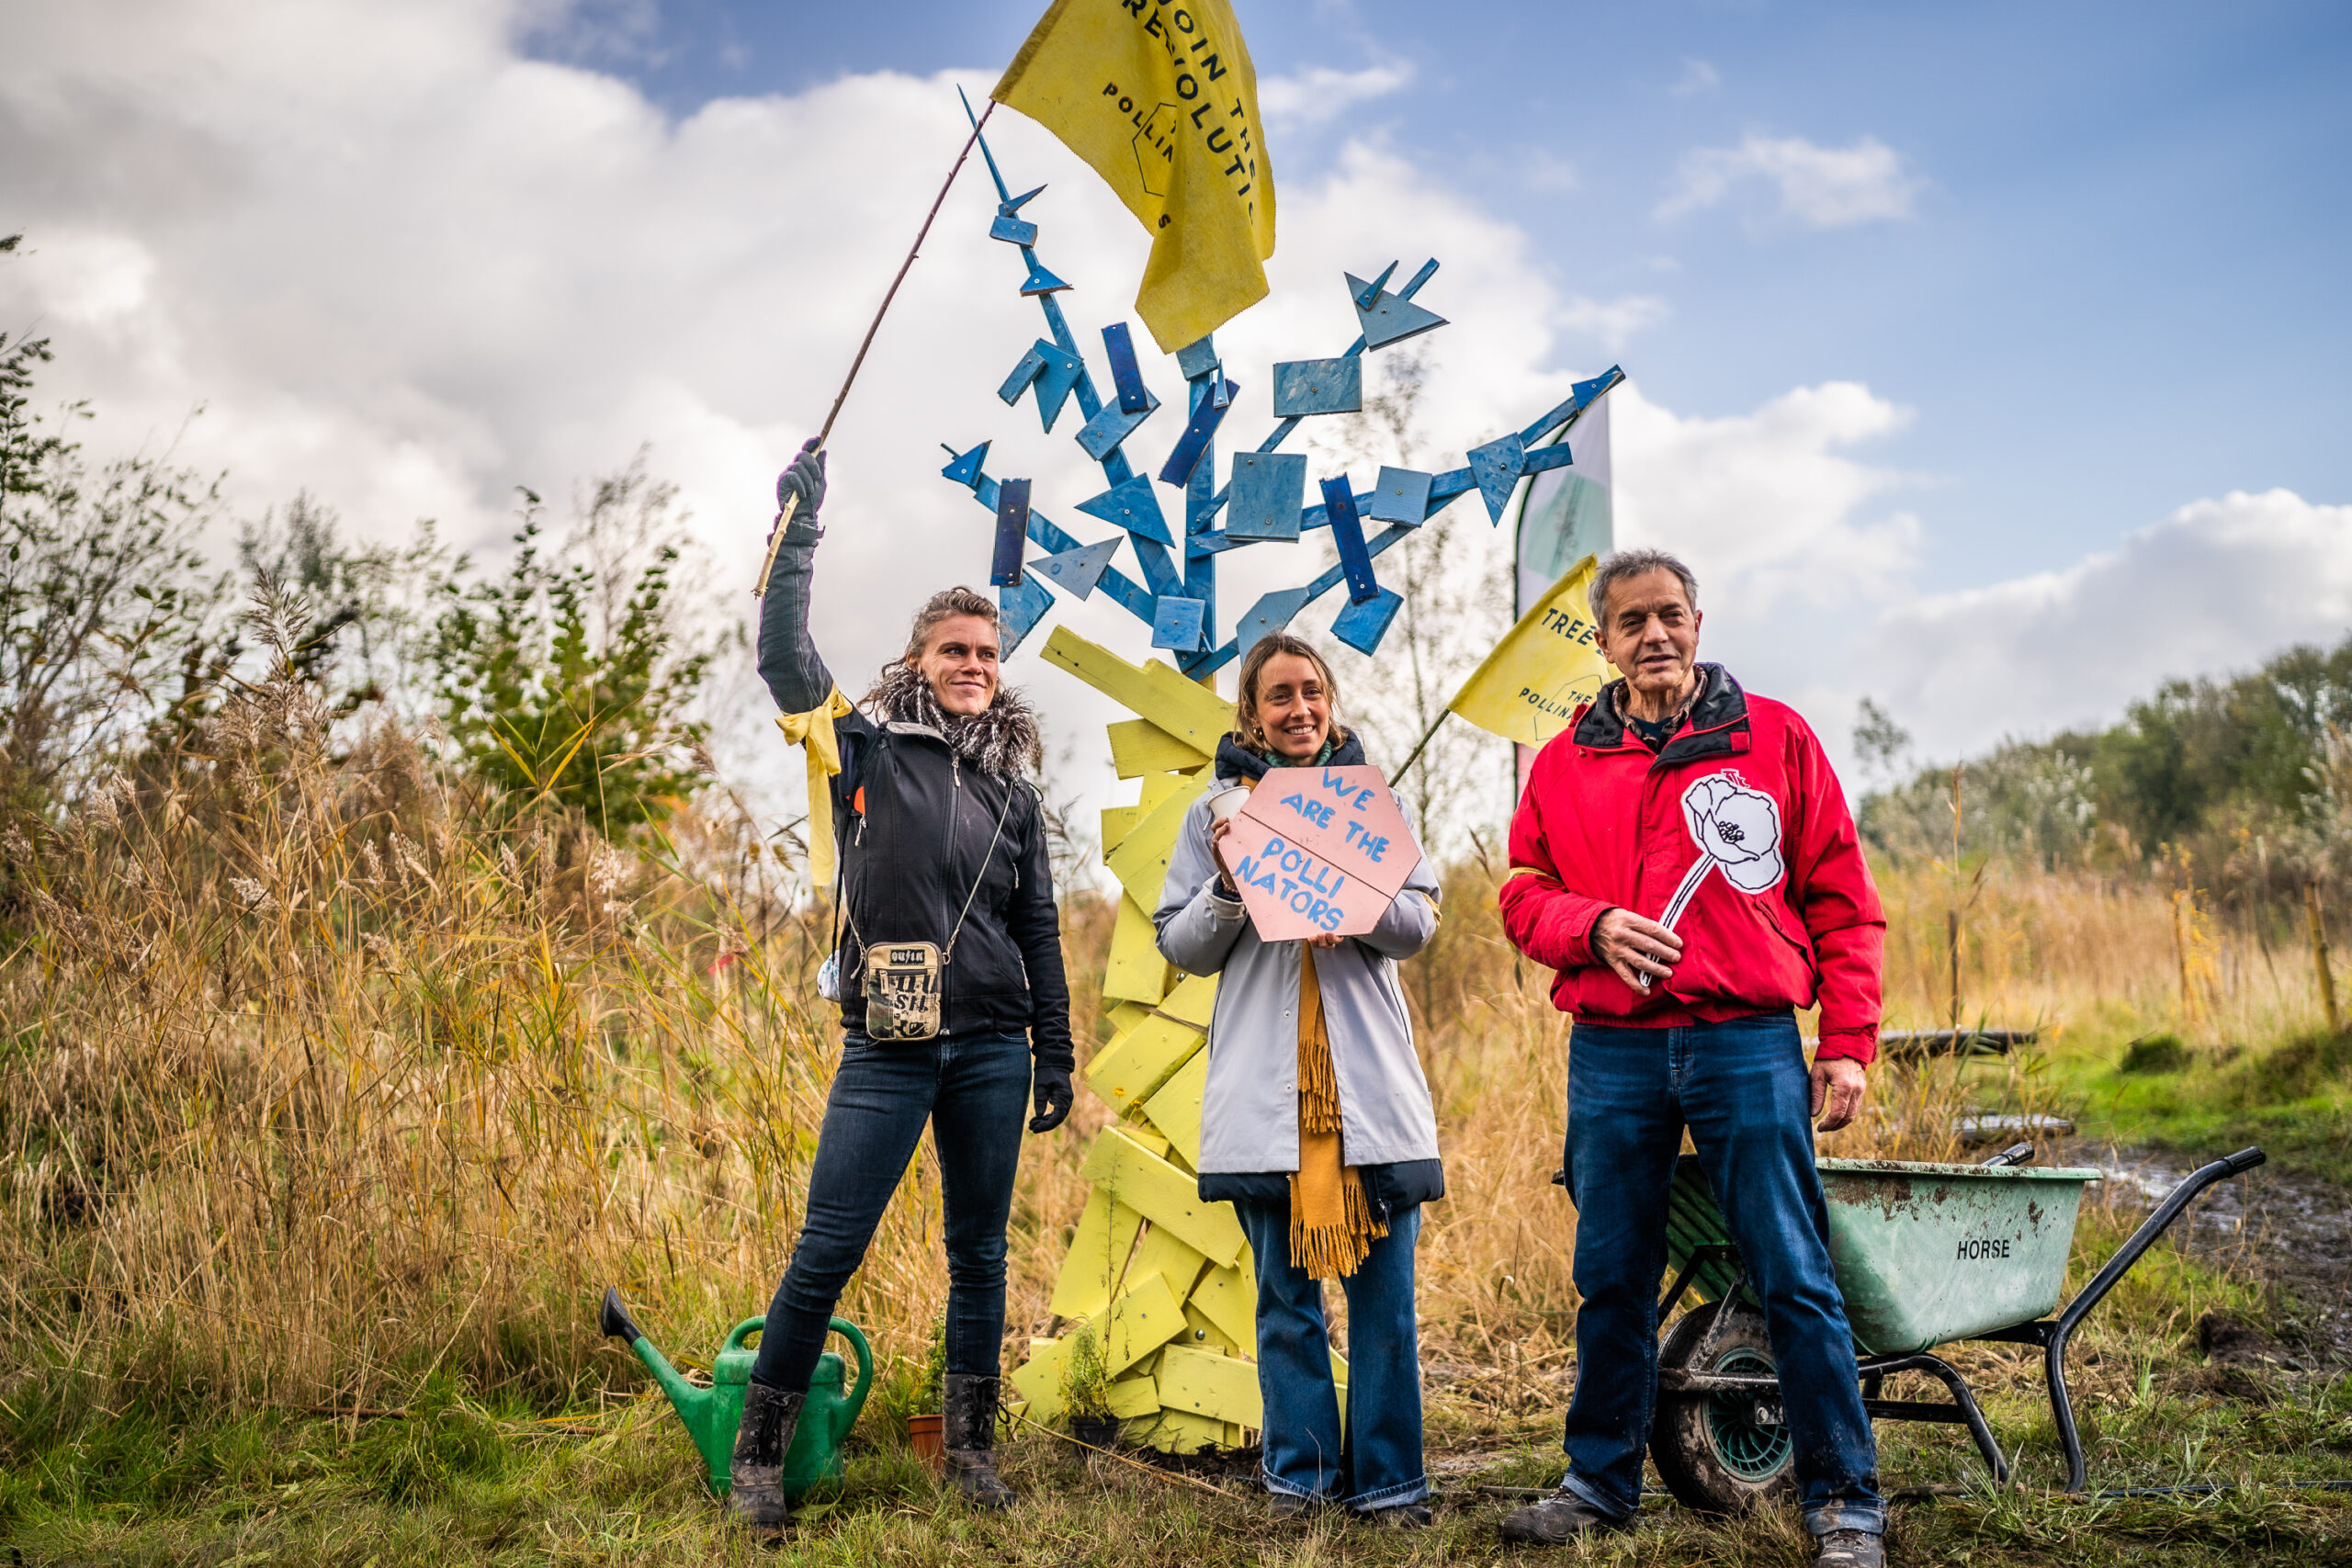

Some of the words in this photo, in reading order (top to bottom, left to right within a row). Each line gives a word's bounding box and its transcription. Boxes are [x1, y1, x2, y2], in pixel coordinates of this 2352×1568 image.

[1229, 97, 1256, 180] THE
[1542, 608, 1604, 657] TREE
[1567, 691, 1592, 704] THE
[1323, 768, 1374, 811] WE
[1280, 793, 1336, 829] ARE
[1346, 820, 1389, 863] THE
[1235, 855, 1344, 931] NATORS
[1261, 837, 1344, 898] POLLI
[1957, 1239, 2010, 1260] HORSE
